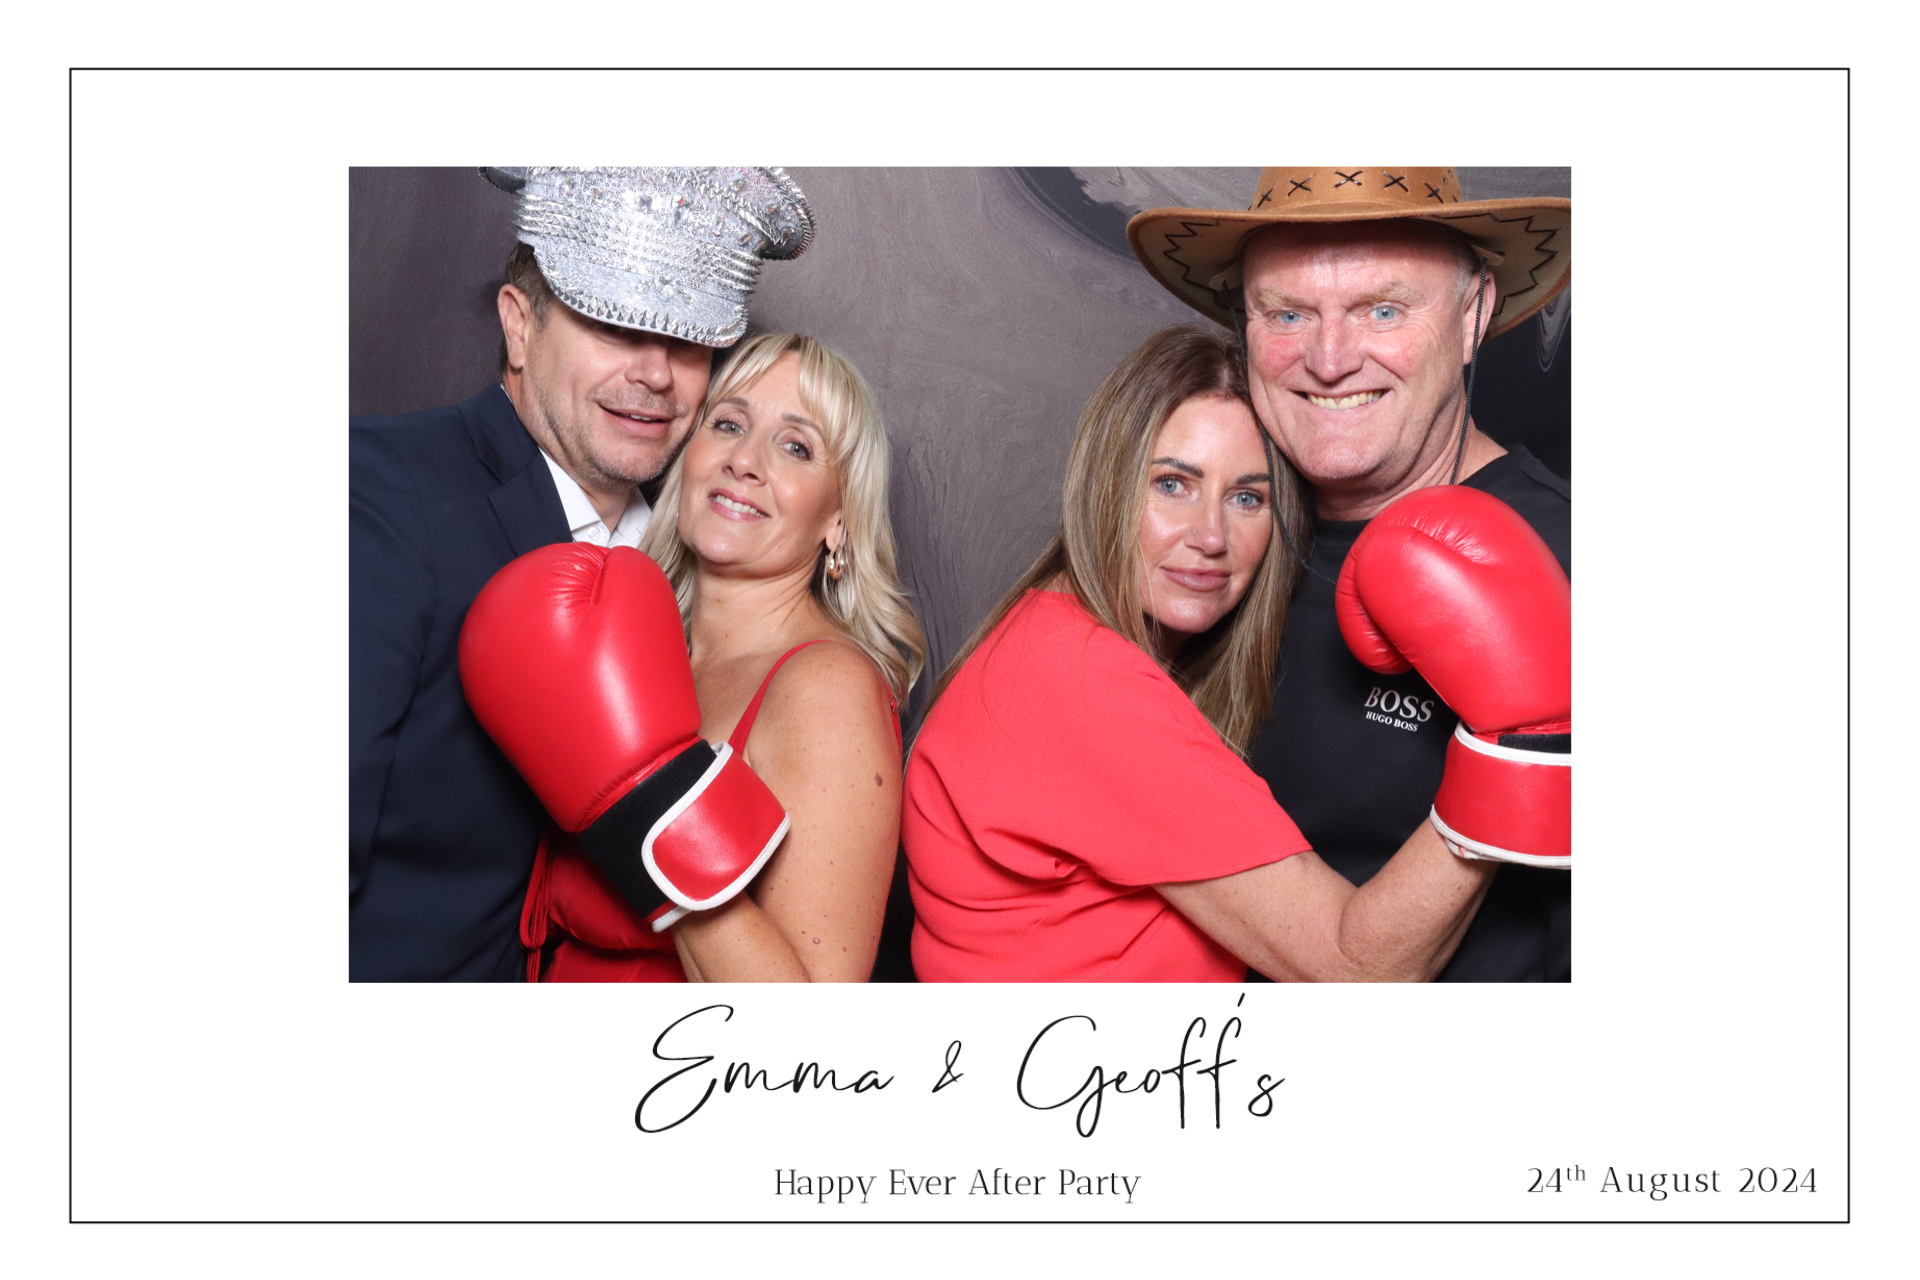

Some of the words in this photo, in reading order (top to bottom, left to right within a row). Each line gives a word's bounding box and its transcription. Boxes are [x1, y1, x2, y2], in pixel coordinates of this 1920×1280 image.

[1363, 686, 1435, 722] BOSS
[1365, 710, 1393, 725] HUGO
[1393, 718, 1419, 732] BOSS
